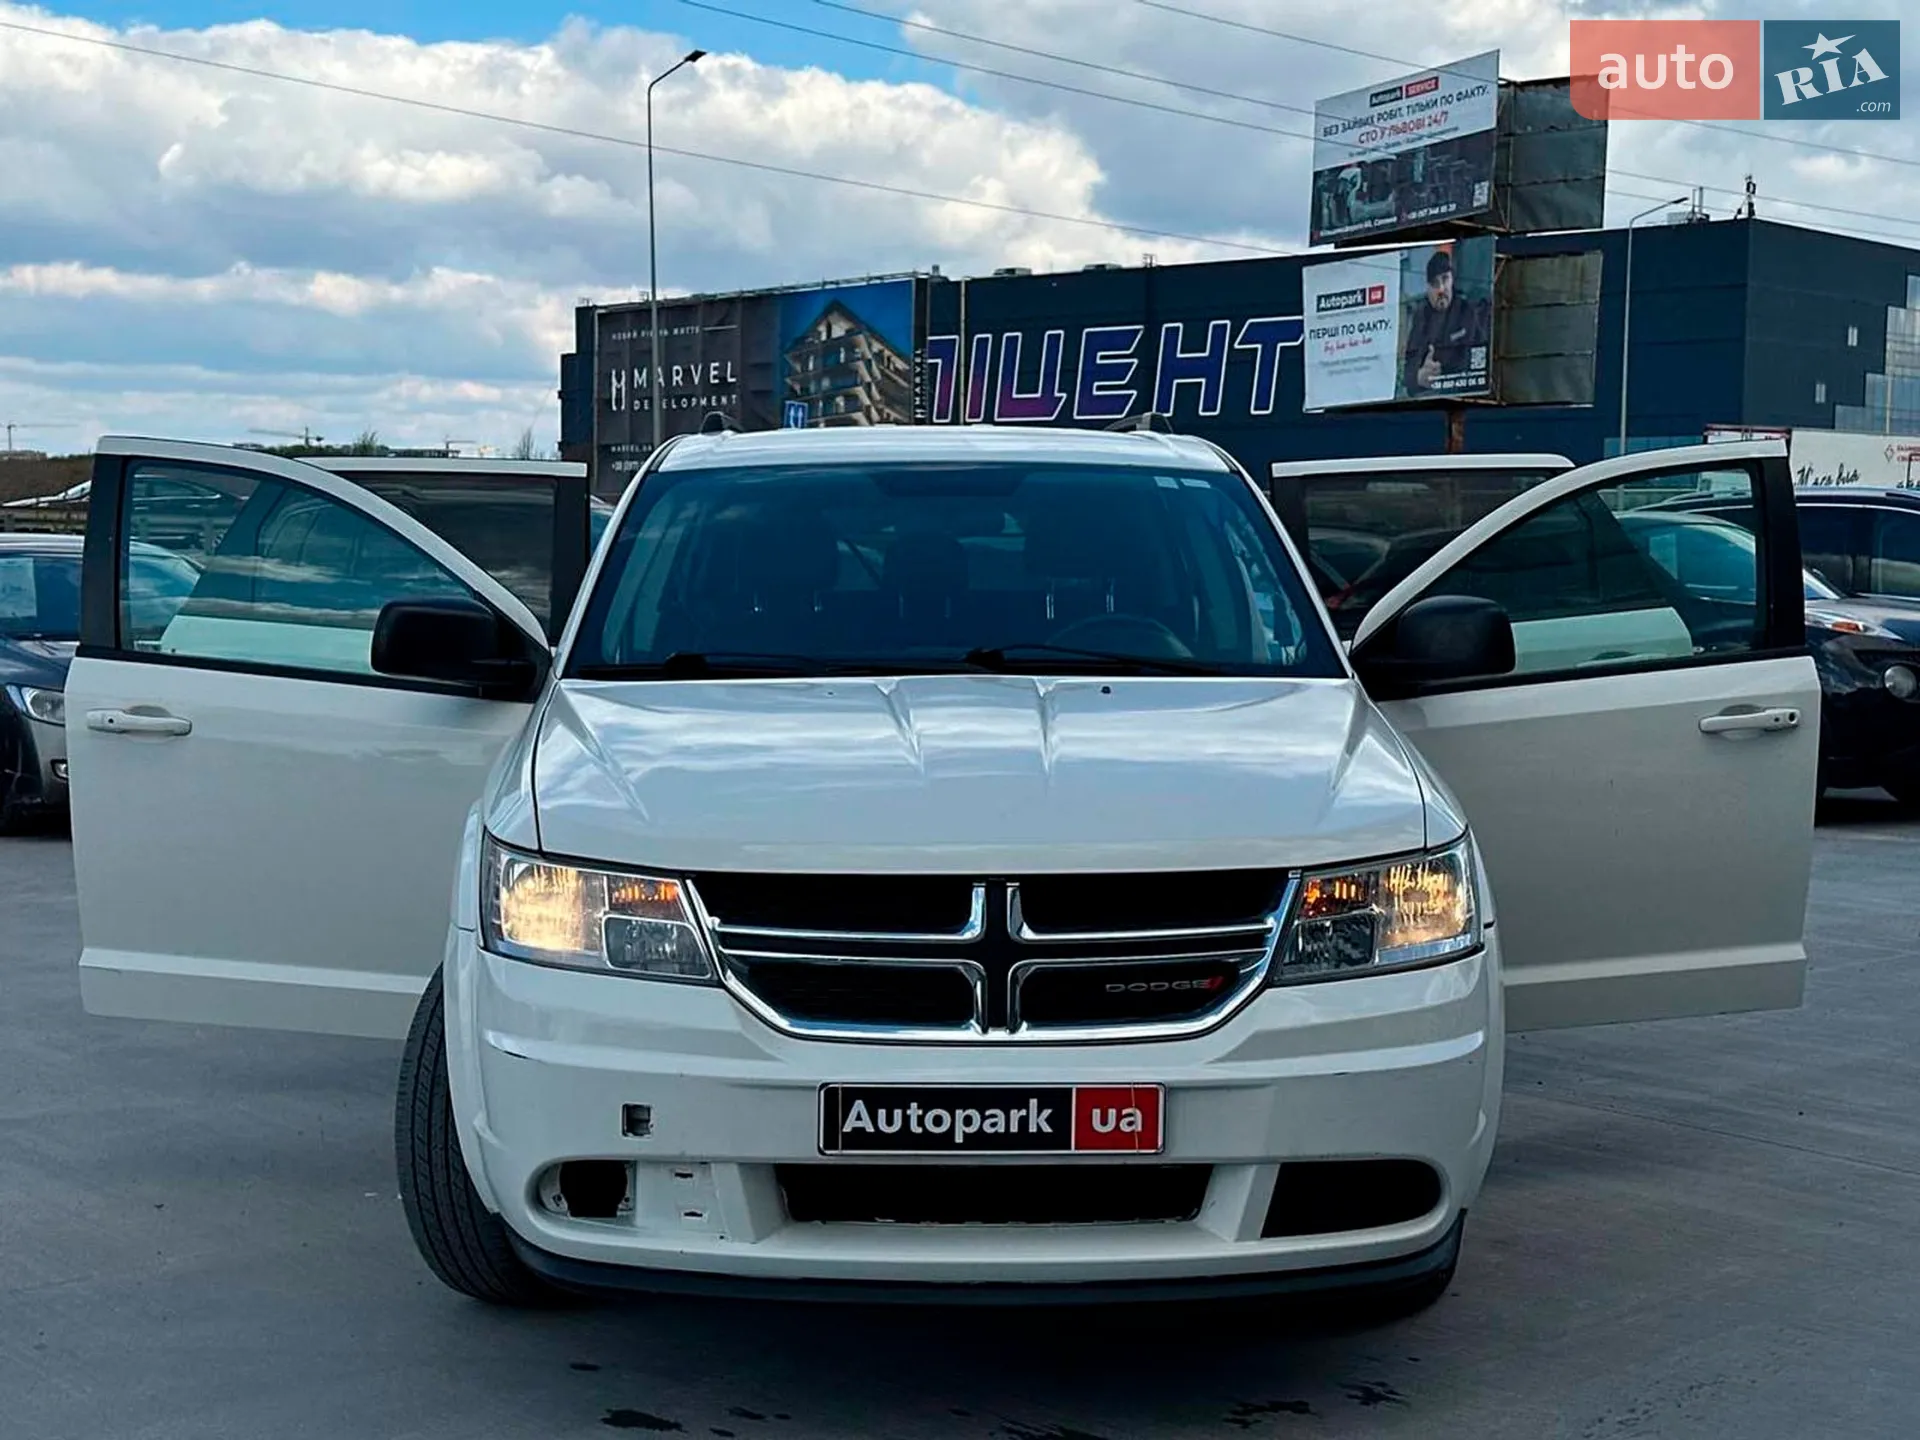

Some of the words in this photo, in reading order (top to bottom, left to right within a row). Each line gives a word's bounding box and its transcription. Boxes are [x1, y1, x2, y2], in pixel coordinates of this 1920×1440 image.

[1323, 123, 1339, 138] БЕЗ
[1406, 97, 1438, 116] ТІЛЬКИ
[1439, 93, 1455, 107] ПО
[1358, 128, 1377, 145] СТО
[1426, 110, 1449, 129] 24/7
[1318, 289, 1364, 309] Autopark
[1309, 326, 1340, 340] ПЕРШІ
[1341, 323, 1356, 336] ПО
[1357, 318, 1392, 334] ФАКТУ.
[633, 394, 737, 411] DEELOPMENT
[1105, 979, 1211, 993] DODGE
[842, 1098, 1053, 1143] Autopark
[1091, 1107, 1143, 1133] ua
